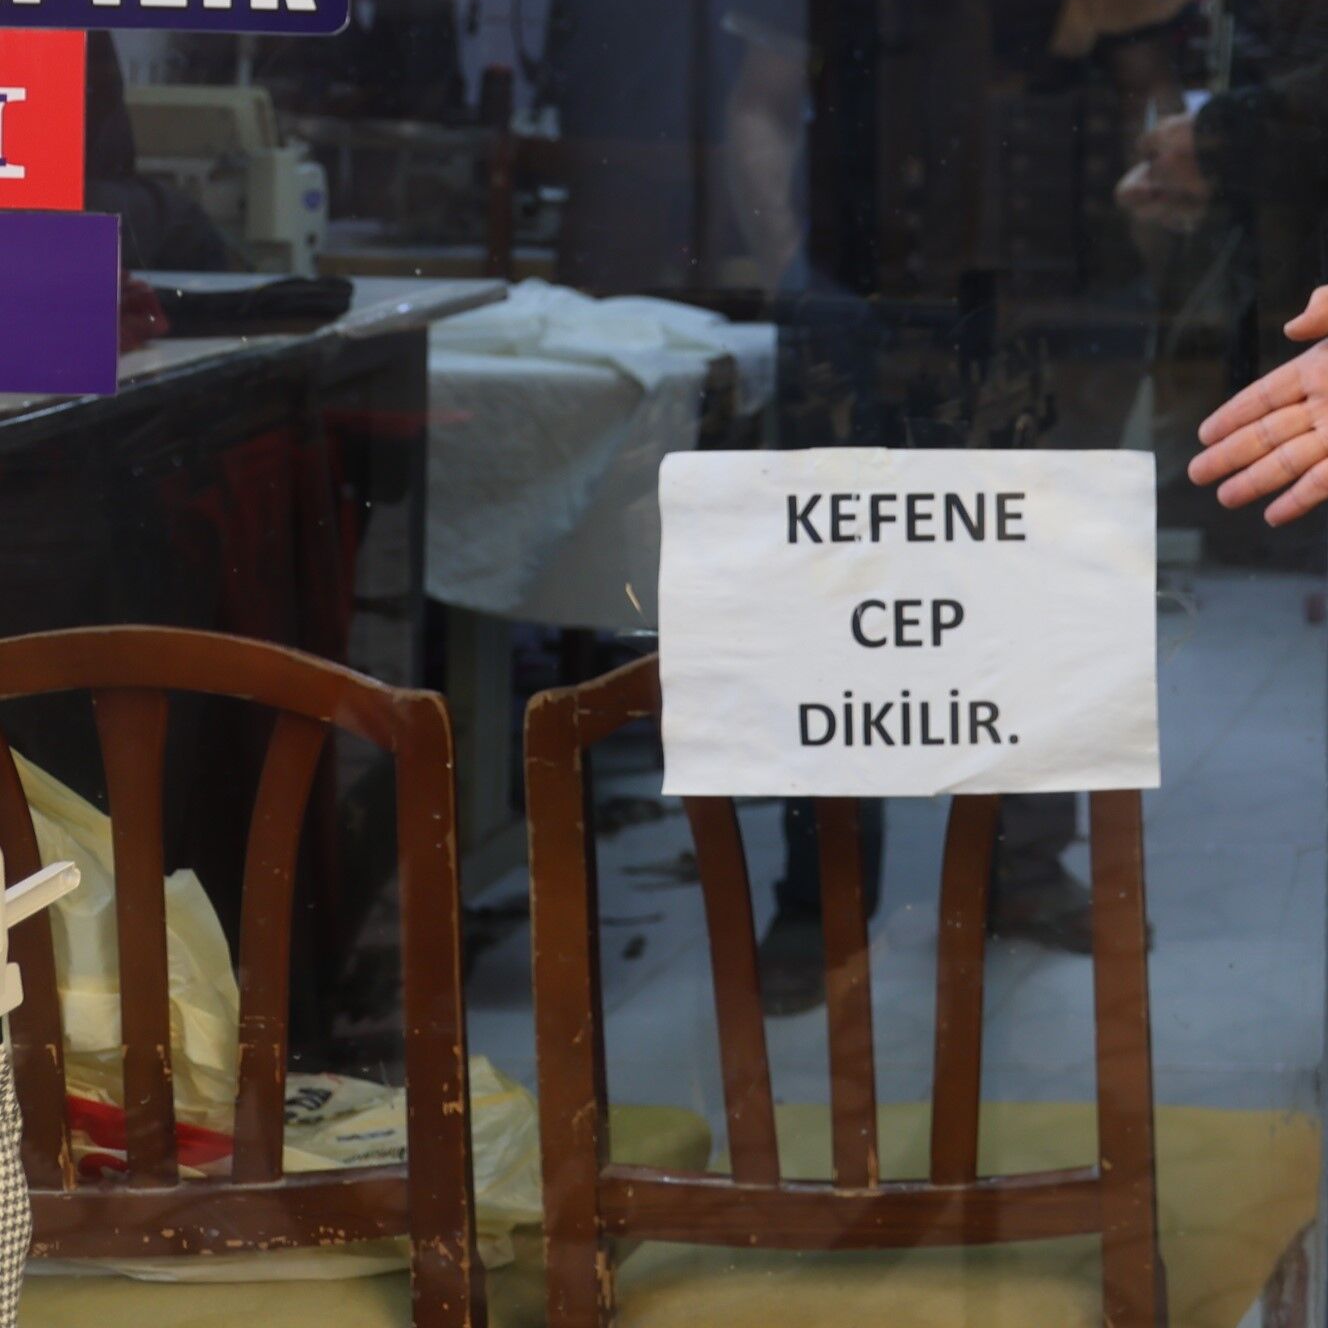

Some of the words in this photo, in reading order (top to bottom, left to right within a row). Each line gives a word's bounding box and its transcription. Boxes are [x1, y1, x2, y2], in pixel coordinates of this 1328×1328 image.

[786, 492, 1026, 545] KEFENE
[851, 599, 965, 649] CEP
[798, 690, 1020, 748] DİKİLİR.
